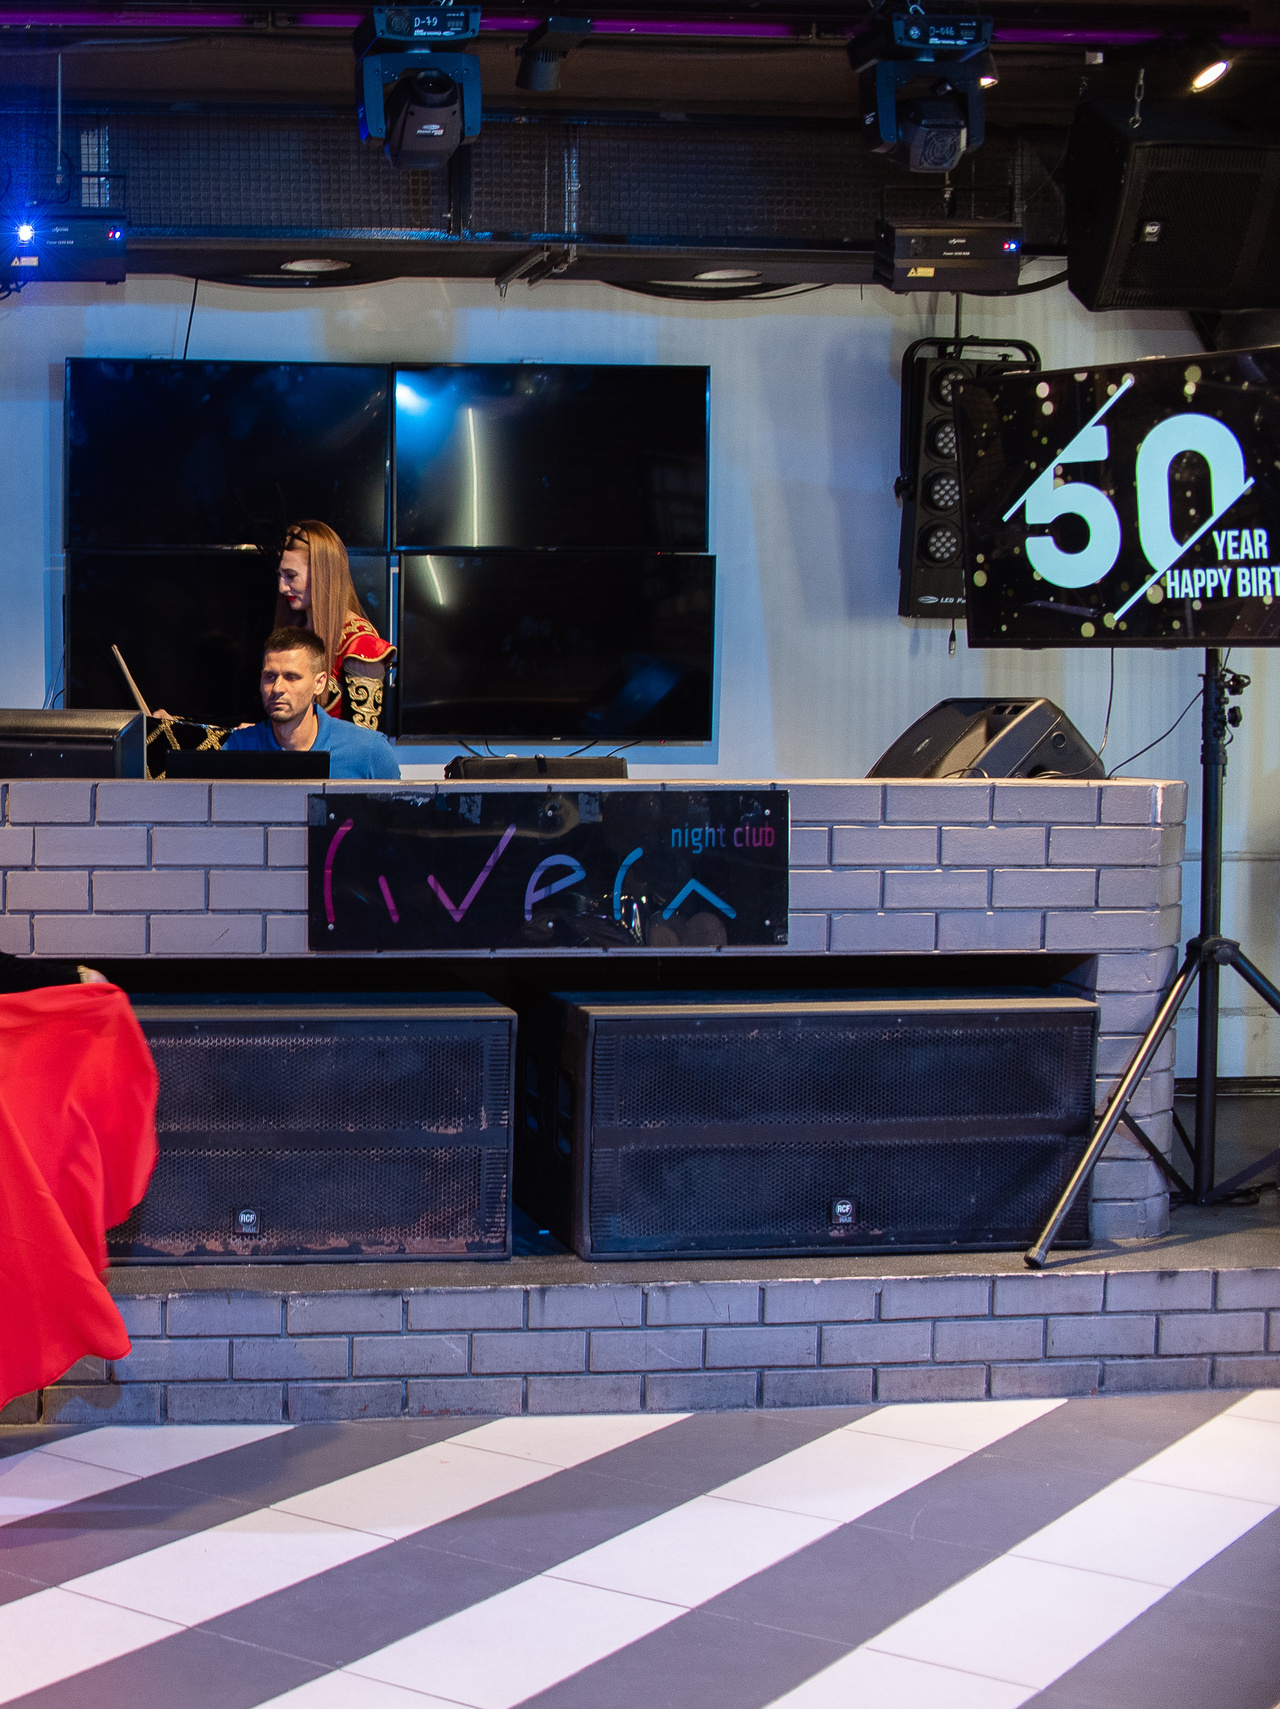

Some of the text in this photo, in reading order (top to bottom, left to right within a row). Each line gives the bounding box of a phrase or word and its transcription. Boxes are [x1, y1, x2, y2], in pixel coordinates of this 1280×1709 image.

[1025, 412, 1248, 589] 50
[1212, 528, 1270, 560] YEAR
[1166, 568, 1232, 599] HAPPY
[671, 821, 775, 854] night club
[240, 1214, 255, 1223] RCF
[837, 1204, 851, 1213] RCF
